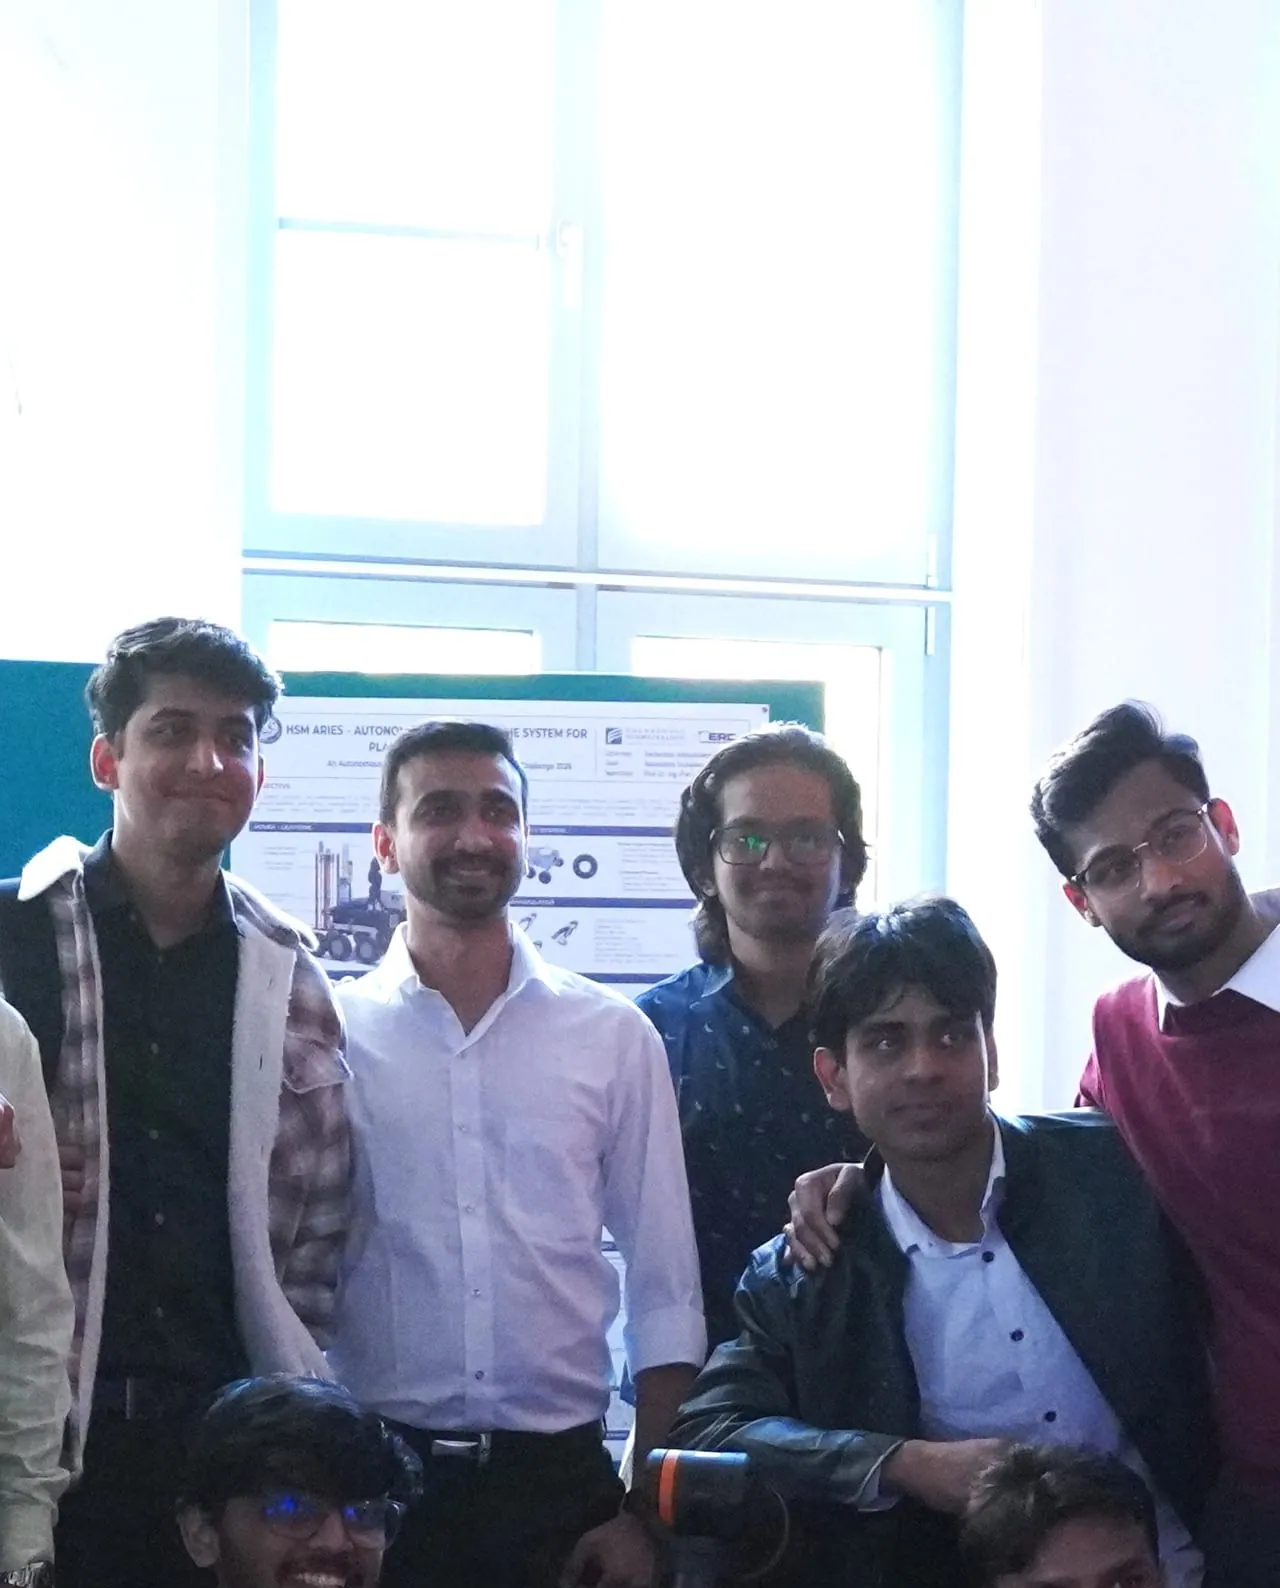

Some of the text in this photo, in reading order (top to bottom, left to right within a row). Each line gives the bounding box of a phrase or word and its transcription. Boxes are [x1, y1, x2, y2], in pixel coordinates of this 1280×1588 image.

[286, 725, 310, 736] HSM
[312, 725, 344, 736] ARIES
[354, 725, 403, 736] AUTONO
[522, 727, 563, 738] SYSTEM
[566, 728, 588, 739] FOR
